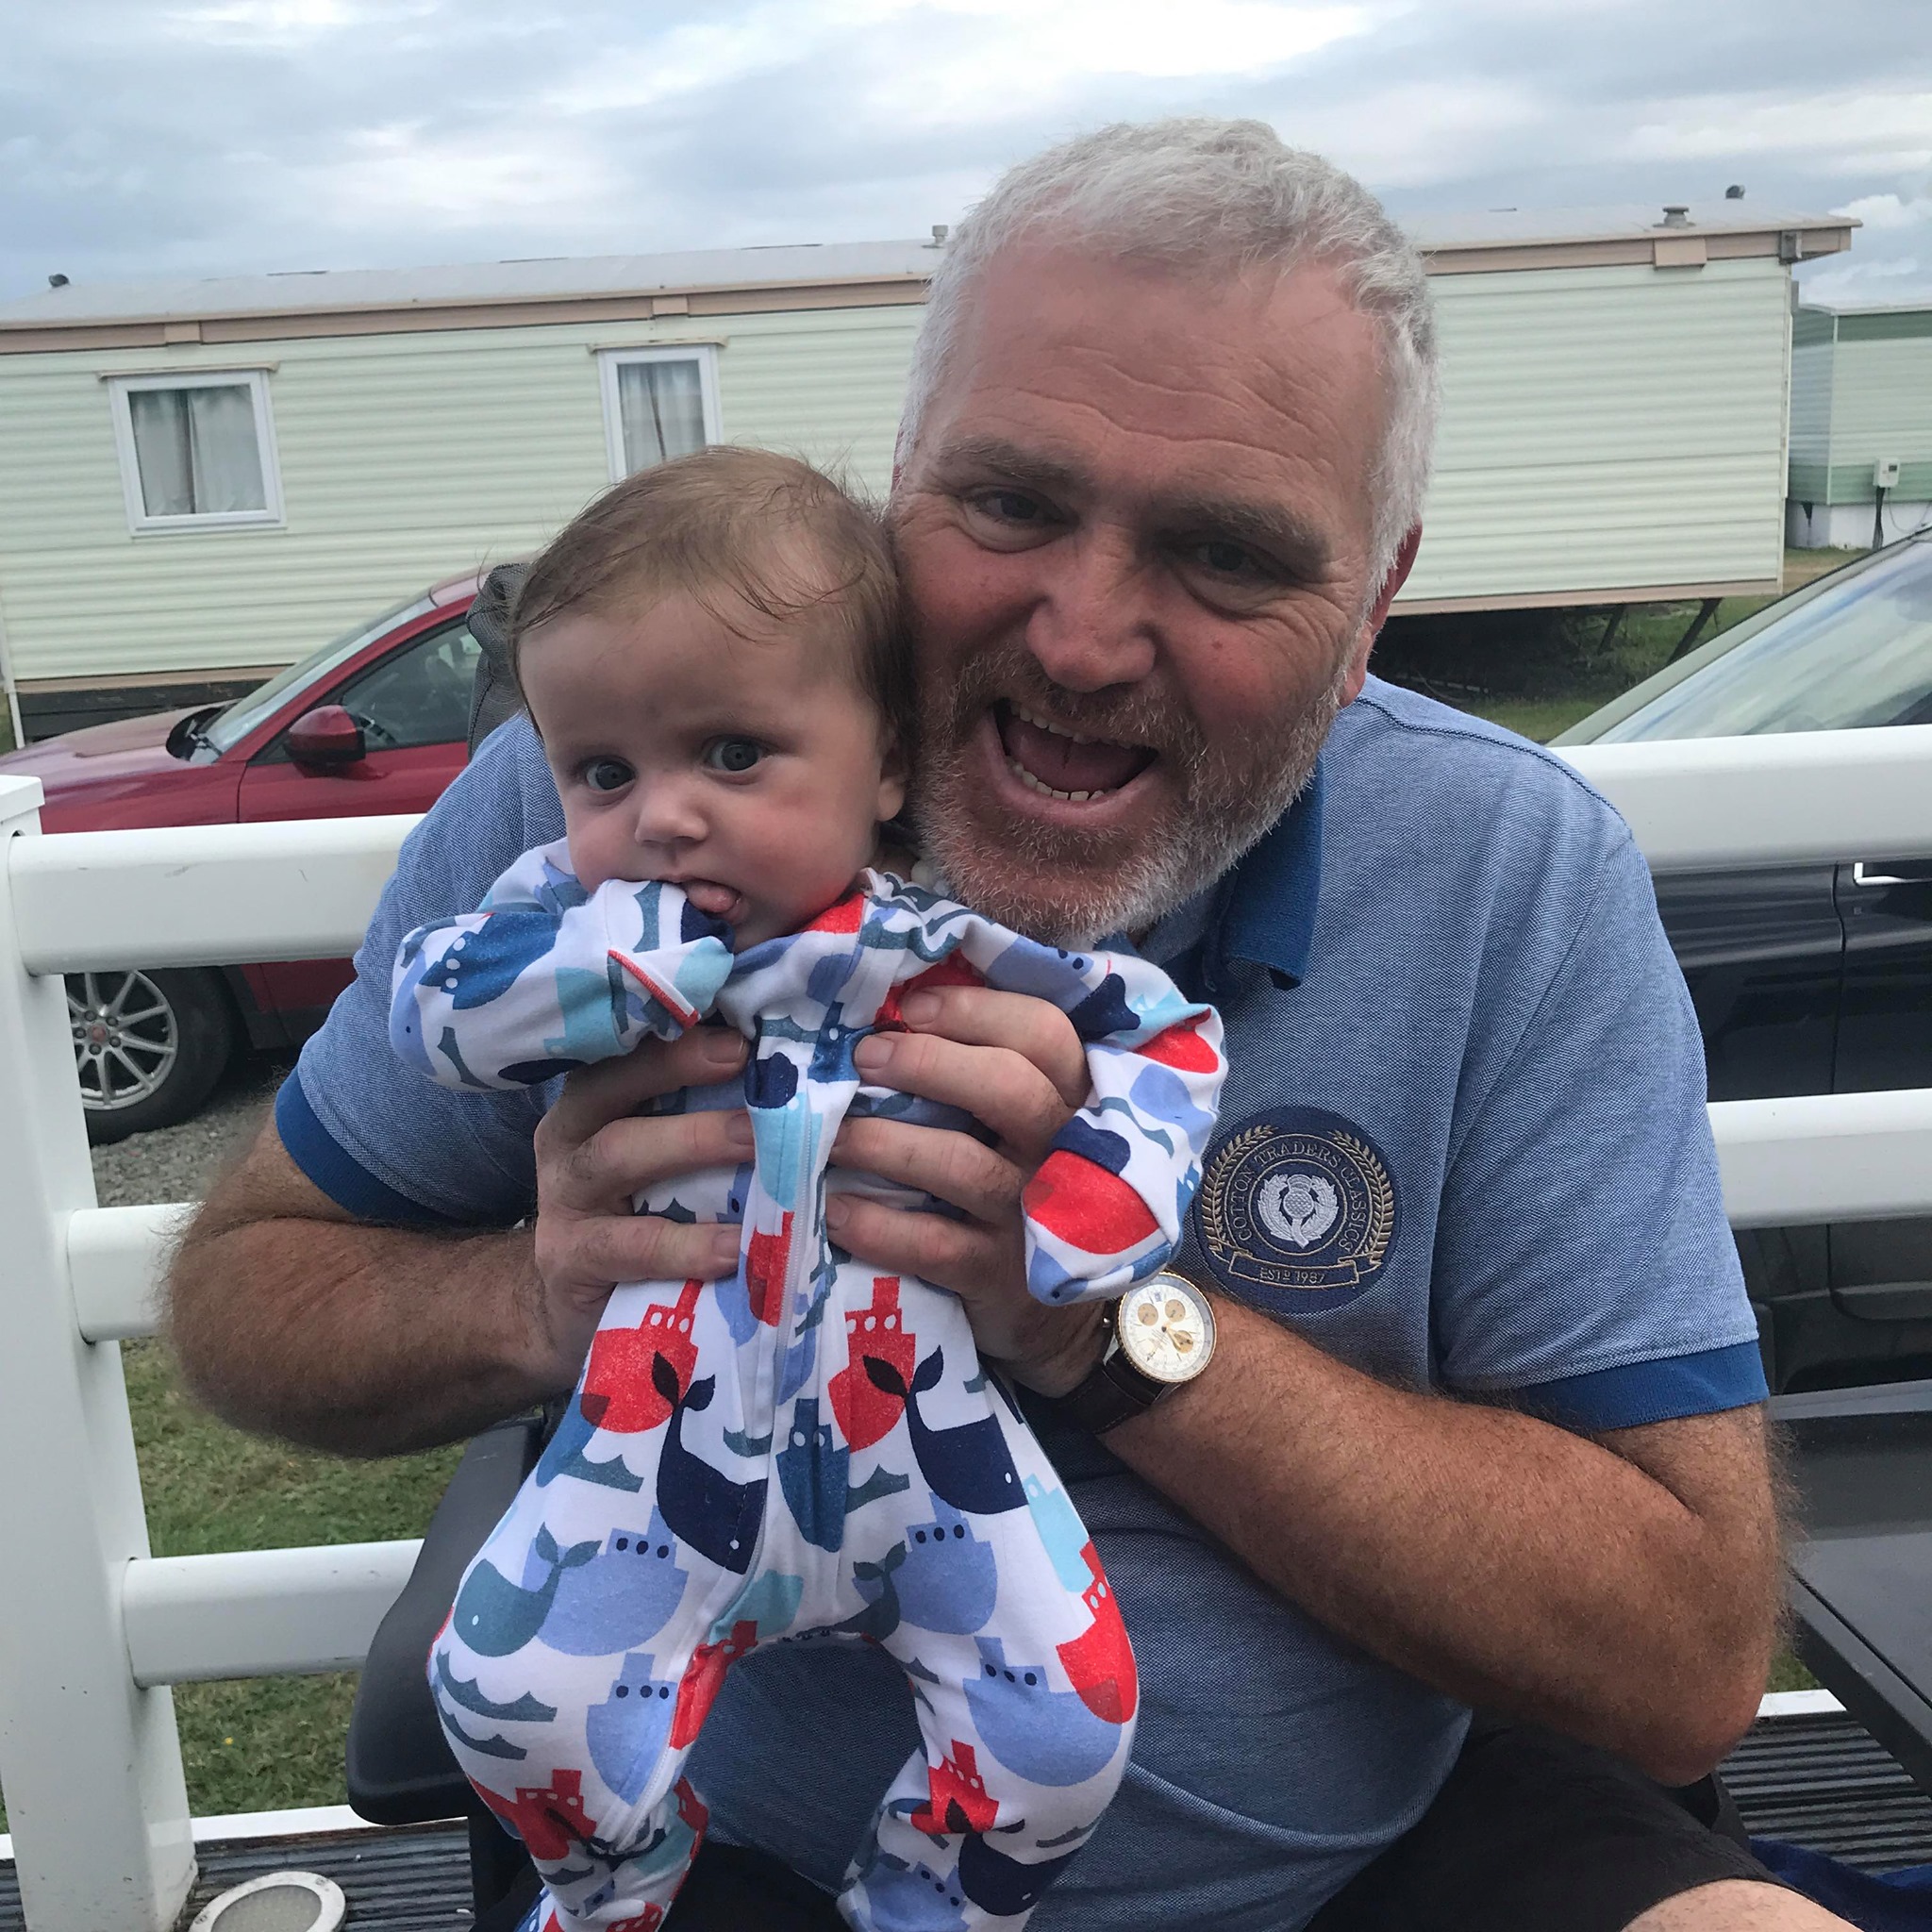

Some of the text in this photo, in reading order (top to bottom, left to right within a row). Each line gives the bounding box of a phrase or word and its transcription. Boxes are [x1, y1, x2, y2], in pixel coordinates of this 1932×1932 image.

[1229, 1141, 1367, 1252] COTTON TRADERS CLASSICS
[1295, 1270, 1325, 1283] 1987
